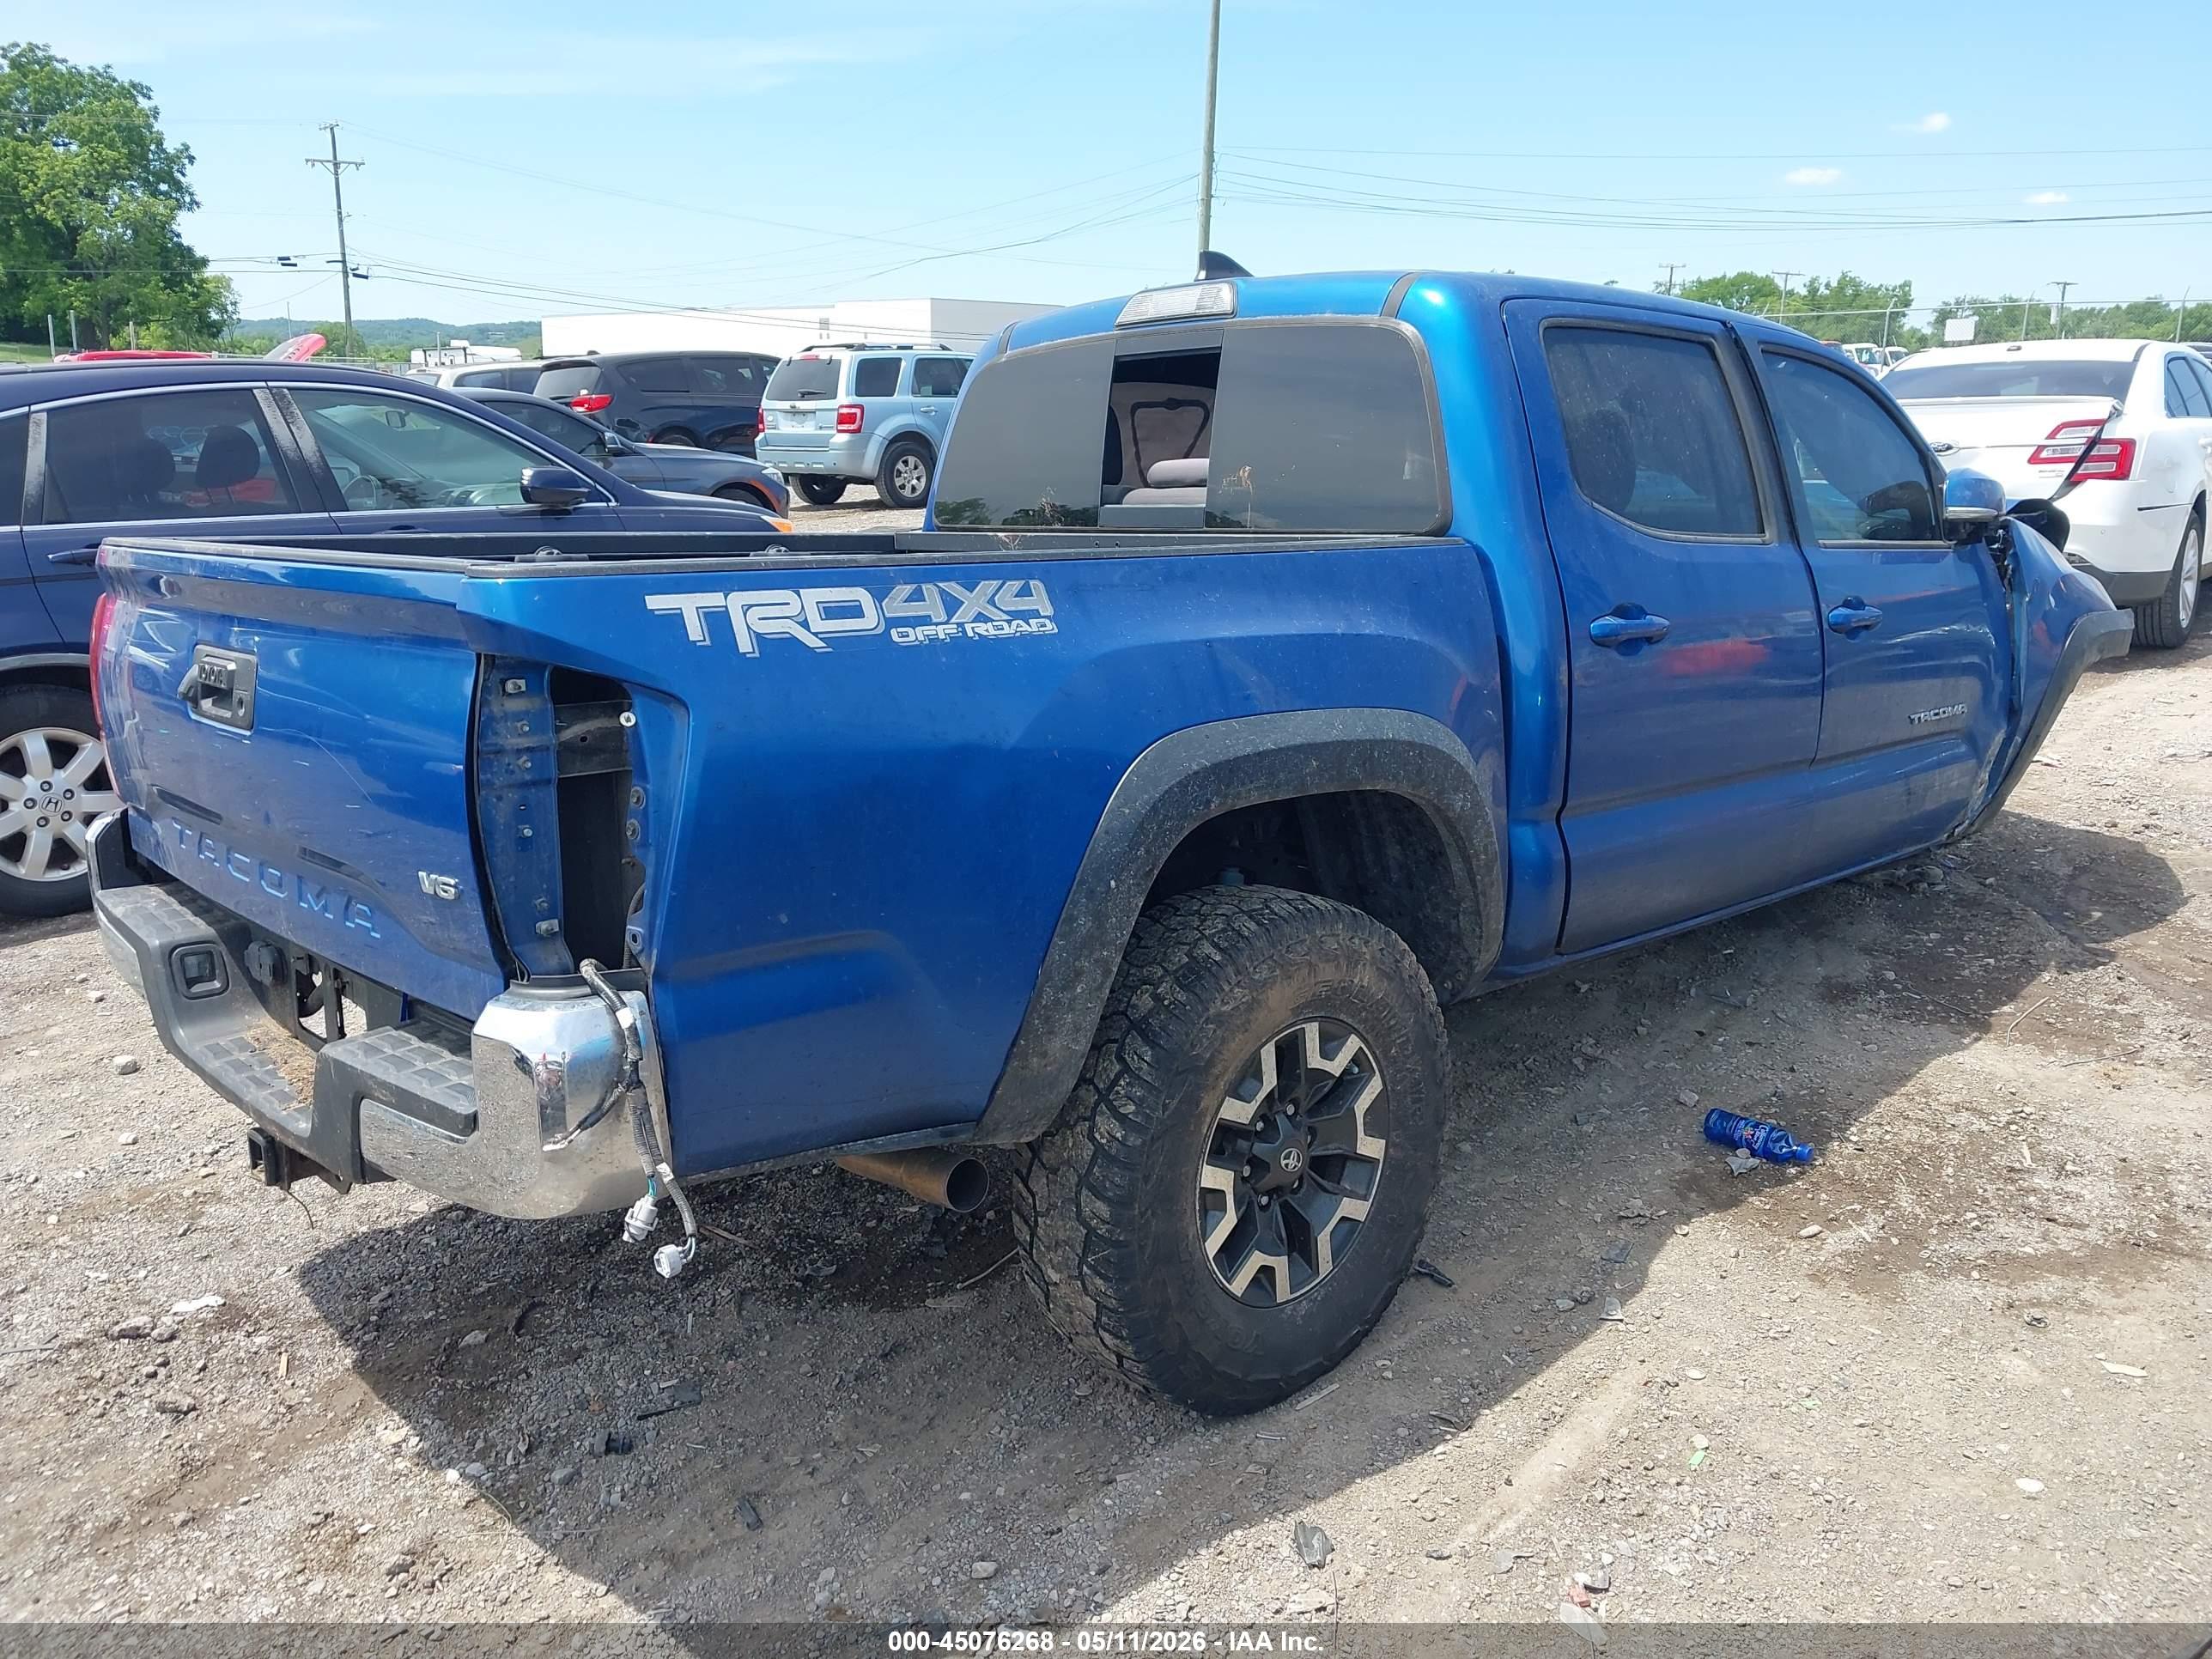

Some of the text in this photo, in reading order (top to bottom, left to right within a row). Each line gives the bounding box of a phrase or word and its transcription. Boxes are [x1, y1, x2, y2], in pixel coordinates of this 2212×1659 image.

[645, 586, 884, 658] TRD
[890, 617, 1058, 646] OFF ROAD
[1908, 702, 1968, 725] TACOMA
[171, 816, 381, 939] TACOMA
[417, 870, 461, 900] V6
